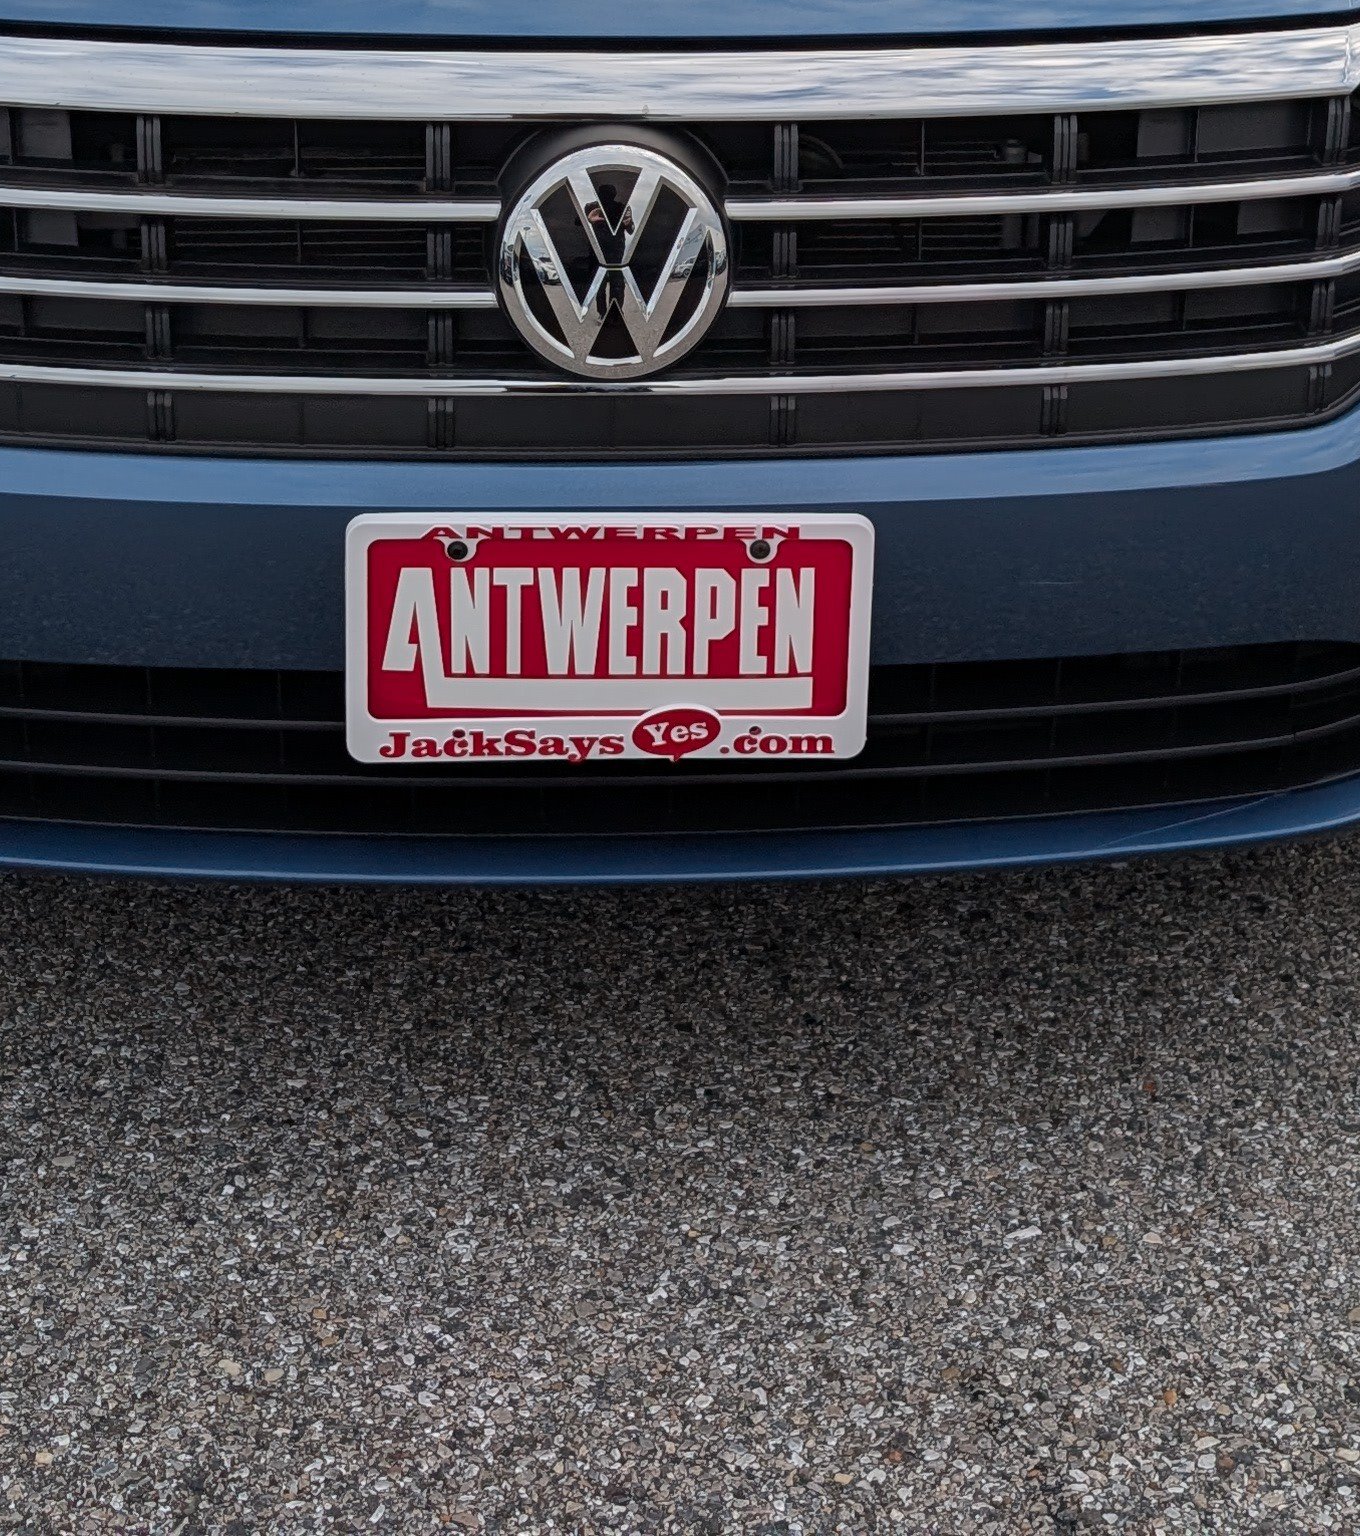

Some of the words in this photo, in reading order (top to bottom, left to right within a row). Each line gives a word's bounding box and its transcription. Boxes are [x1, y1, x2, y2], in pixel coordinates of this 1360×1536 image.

[510, 154, 714, 371] VW
[420, 526, 800, 540] ANTWERPEN
[382, 567, 815, 677] ANTWERPEN
[379, 729, 625, 762] JackSays
[643, 721, 709, 748] Yes
[719, 733, 835, 755] .com
